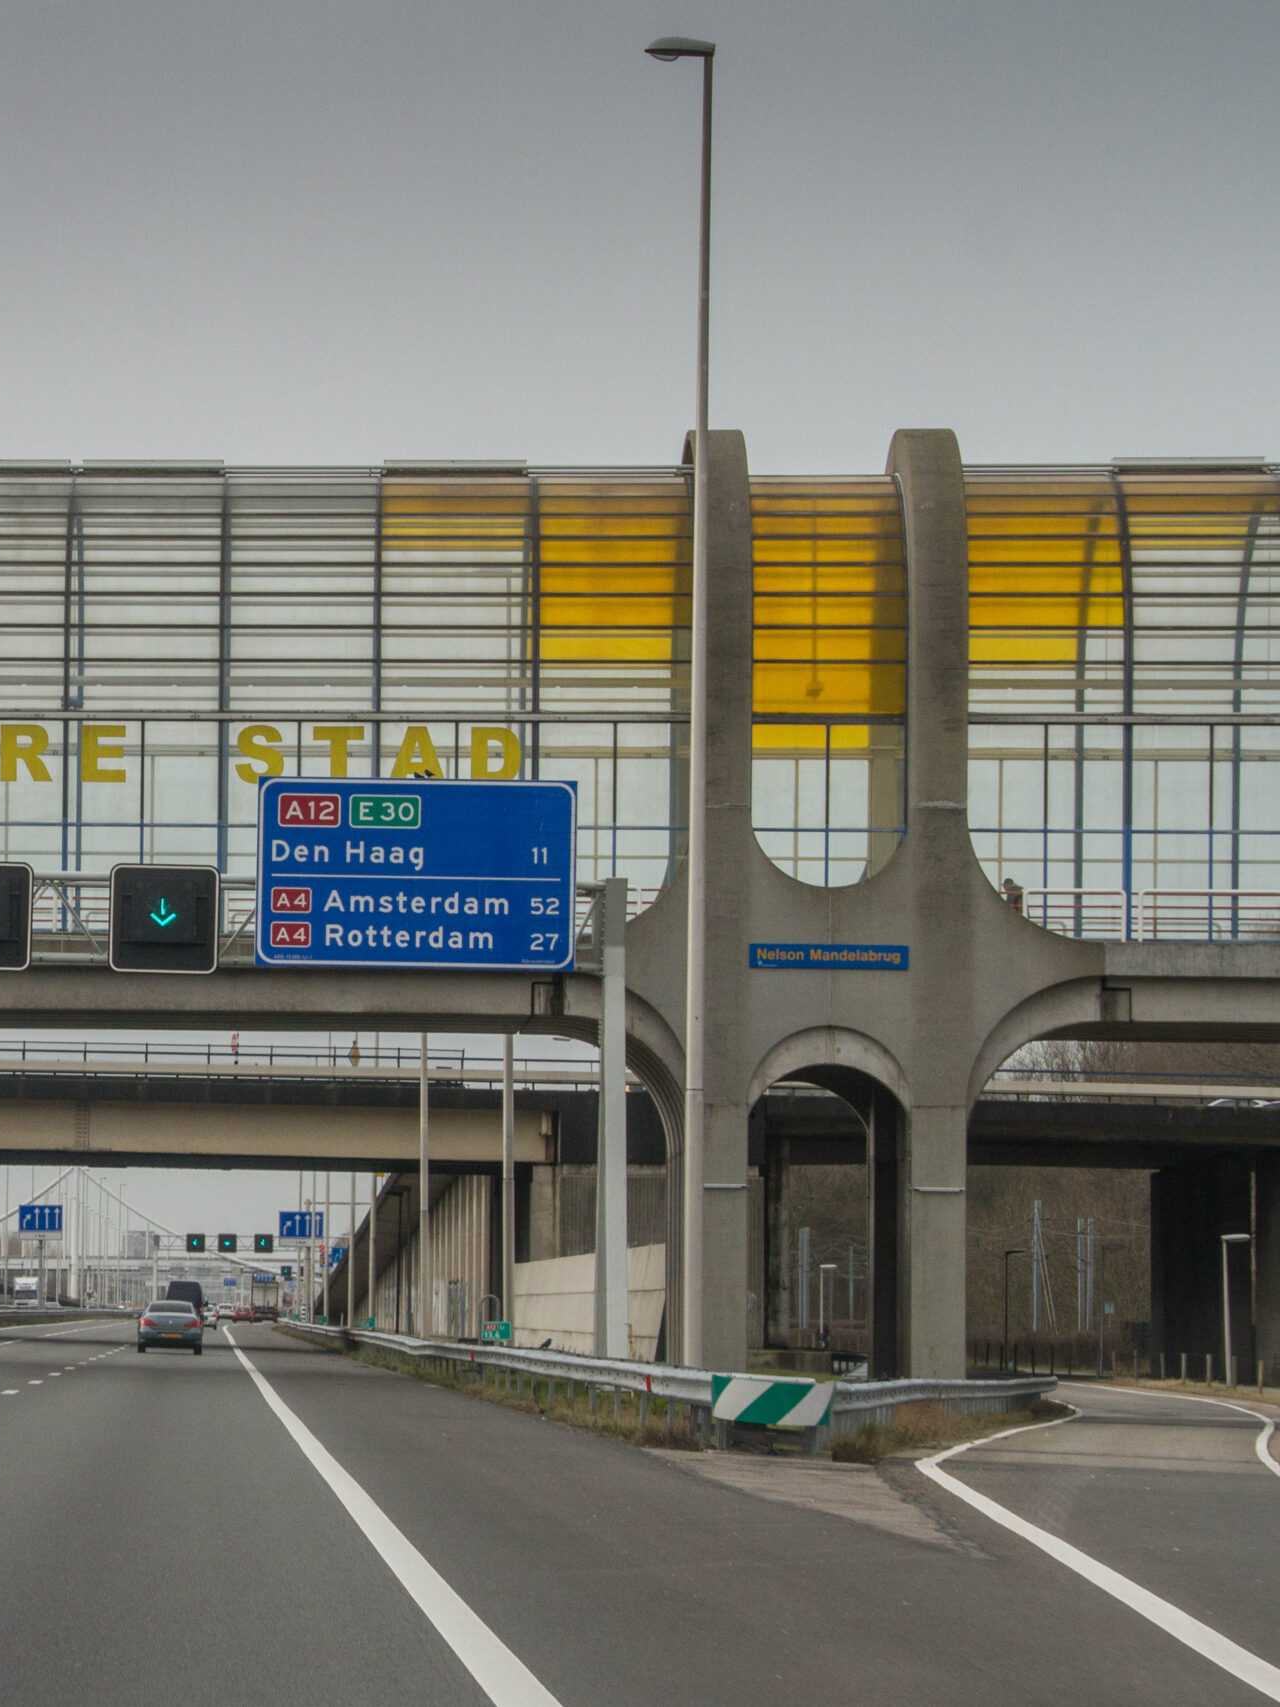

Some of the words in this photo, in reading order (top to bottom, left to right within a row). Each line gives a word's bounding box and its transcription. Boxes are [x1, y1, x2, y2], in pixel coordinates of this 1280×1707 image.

[235, 724, 522, 785] STAD
[285, 800, 335, 820] A12
[271, 839, 330, 862] Den
[345, 840, 424, 871] Haag
[531, 847, 548, 865] 11
[276, 892, 307, 908] A4
[323, 889, 509, 916] Amsterdam
[530, 897, 560, 915] 52
[275, 926, 307, 942] A4
[325, 923, 493, 949] Rotterdam
[530, 933, 559, 951] 27
[757, 948, 804, 961] Nelson
[809, 948, 901, 965] Mandelabrug
